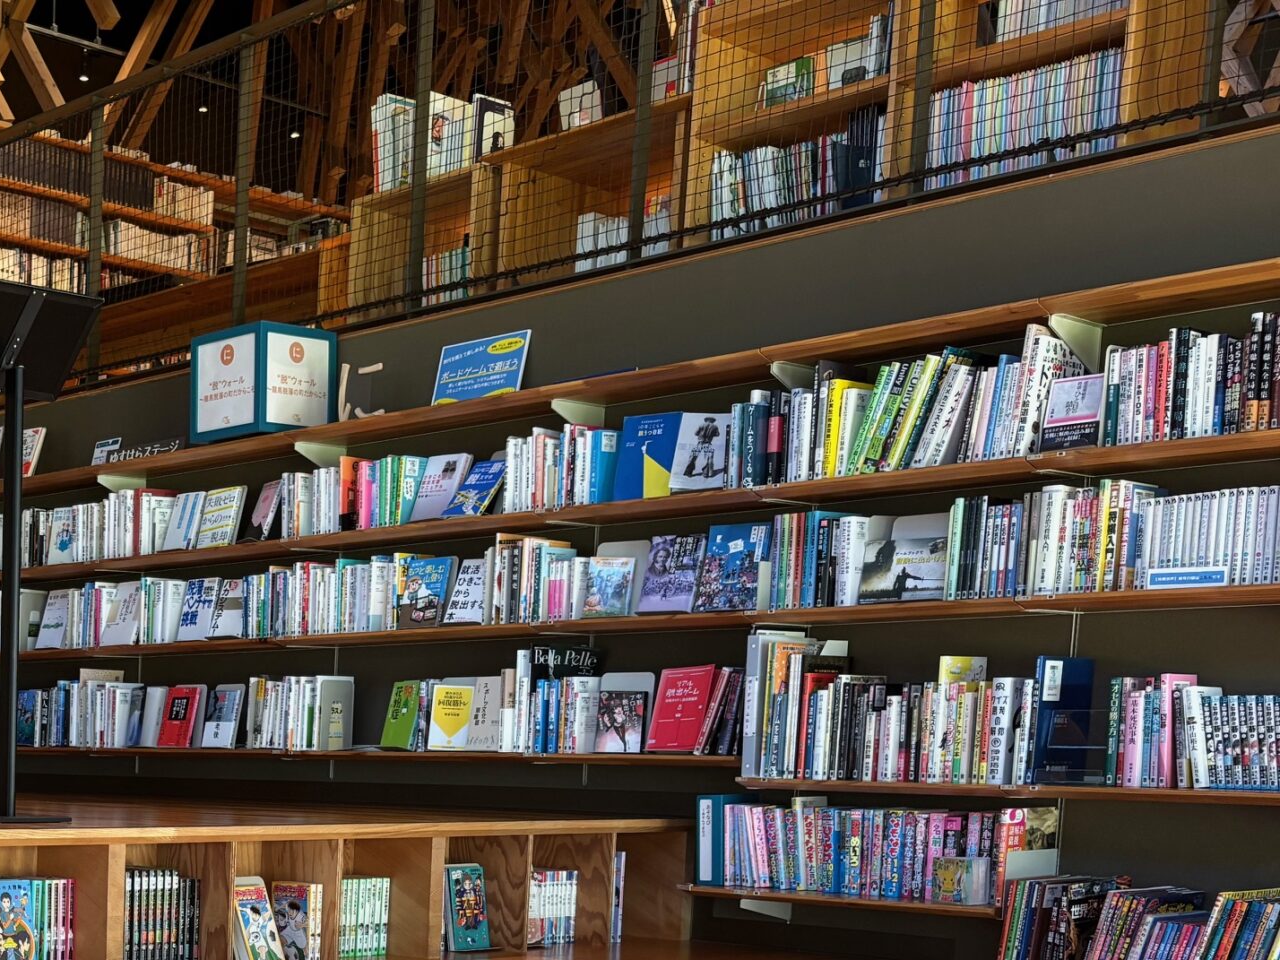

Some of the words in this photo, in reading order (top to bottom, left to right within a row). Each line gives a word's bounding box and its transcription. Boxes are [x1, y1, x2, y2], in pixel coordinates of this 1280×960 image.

[440, 358, 519, 380] ボードゲームで遊ぼう
[337, 362, 385, 422] に
[746, 404, 754, 474] ゲームをつくる
[109, 439, 180, 464] ゆすはらステージ
[205, 494, 237, 508] 失敗ゼロ
[209, 531, 229, 545] 脱却
[460, 564, 481, 575] 就活
[453, 588, 470, 598] から
[448, 599, 484, 611] 脱出する
[445, 612, 455, 621] 本
[534, 648, 562, 665] Bella
[564, 650, 598, 667] Pelle
[665, 685, 700, 697] 脱出ゲーム
[1108, 683, 1119, 736] オセロの勝ち方
[1128, 699, 1139, 746] 基本死活事典
[803, 814, 814, 864] なぞなぞ
[888, 817, 900, 858] なぞなぞ
